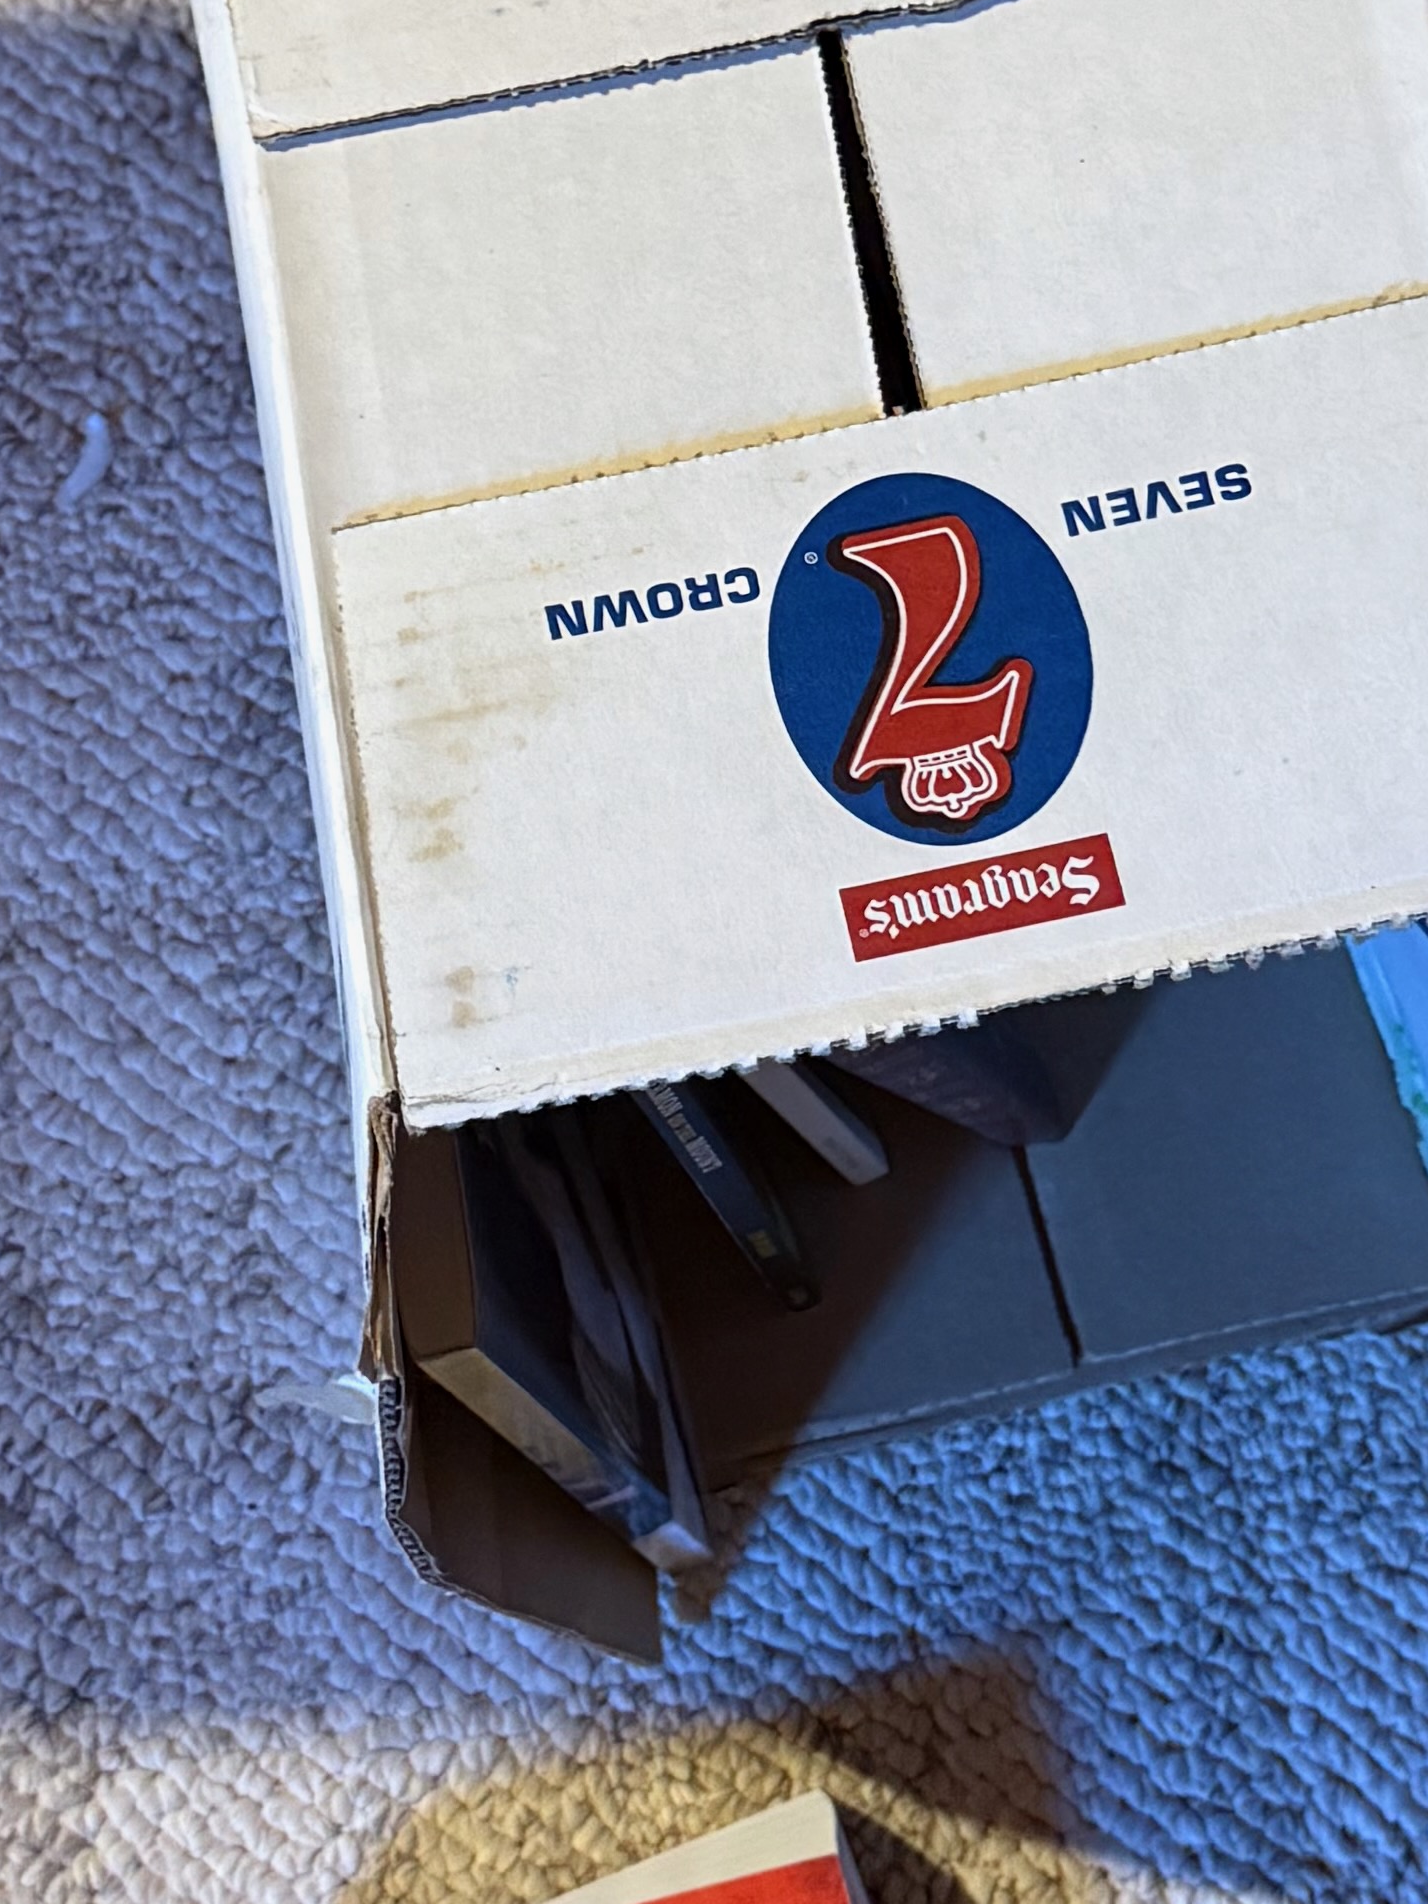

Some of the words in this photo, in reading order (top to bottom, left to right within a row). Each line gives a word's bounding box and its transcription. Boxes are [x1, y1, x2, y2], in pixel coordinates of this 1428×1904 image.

[1061, 462, 1255, 539] SEVEN
[543, 564, 763, 643] CROWN
[861, 853, 1103, 938] Seagram's
